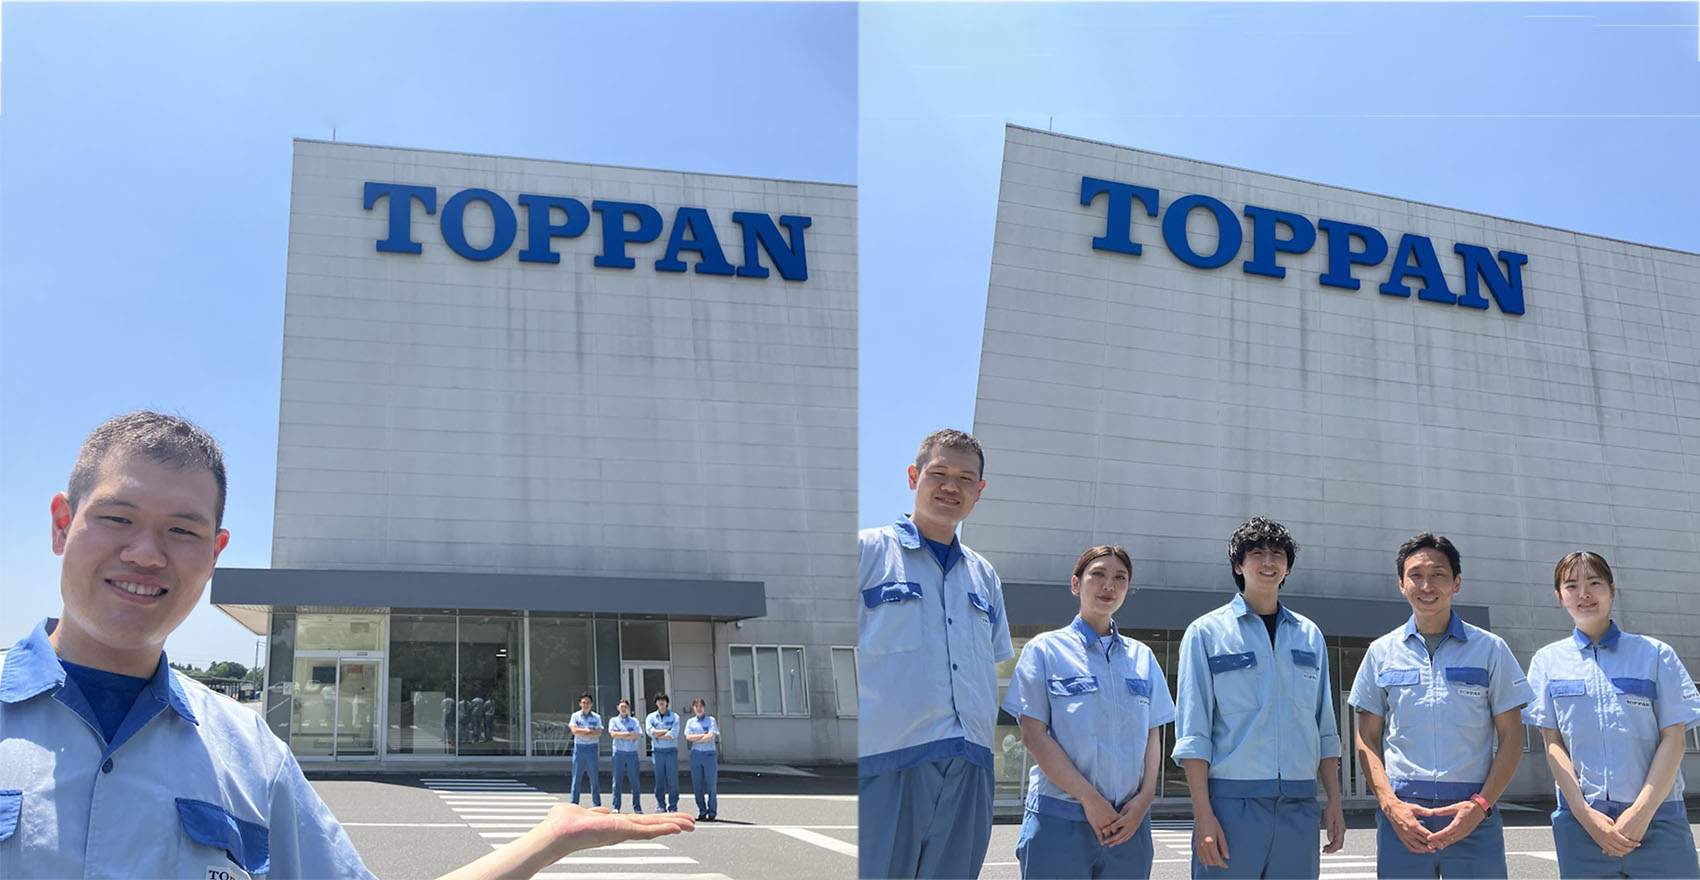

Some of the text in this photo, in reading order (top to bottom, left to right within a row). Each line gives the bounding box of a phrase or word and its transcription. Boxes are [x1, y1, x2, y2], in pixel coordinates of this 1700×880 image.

[363, 181, 812, 281] TOPPAN
[1080, 176, 1528, 315] TOPPAN
[208, 870, 236, 880] TO
